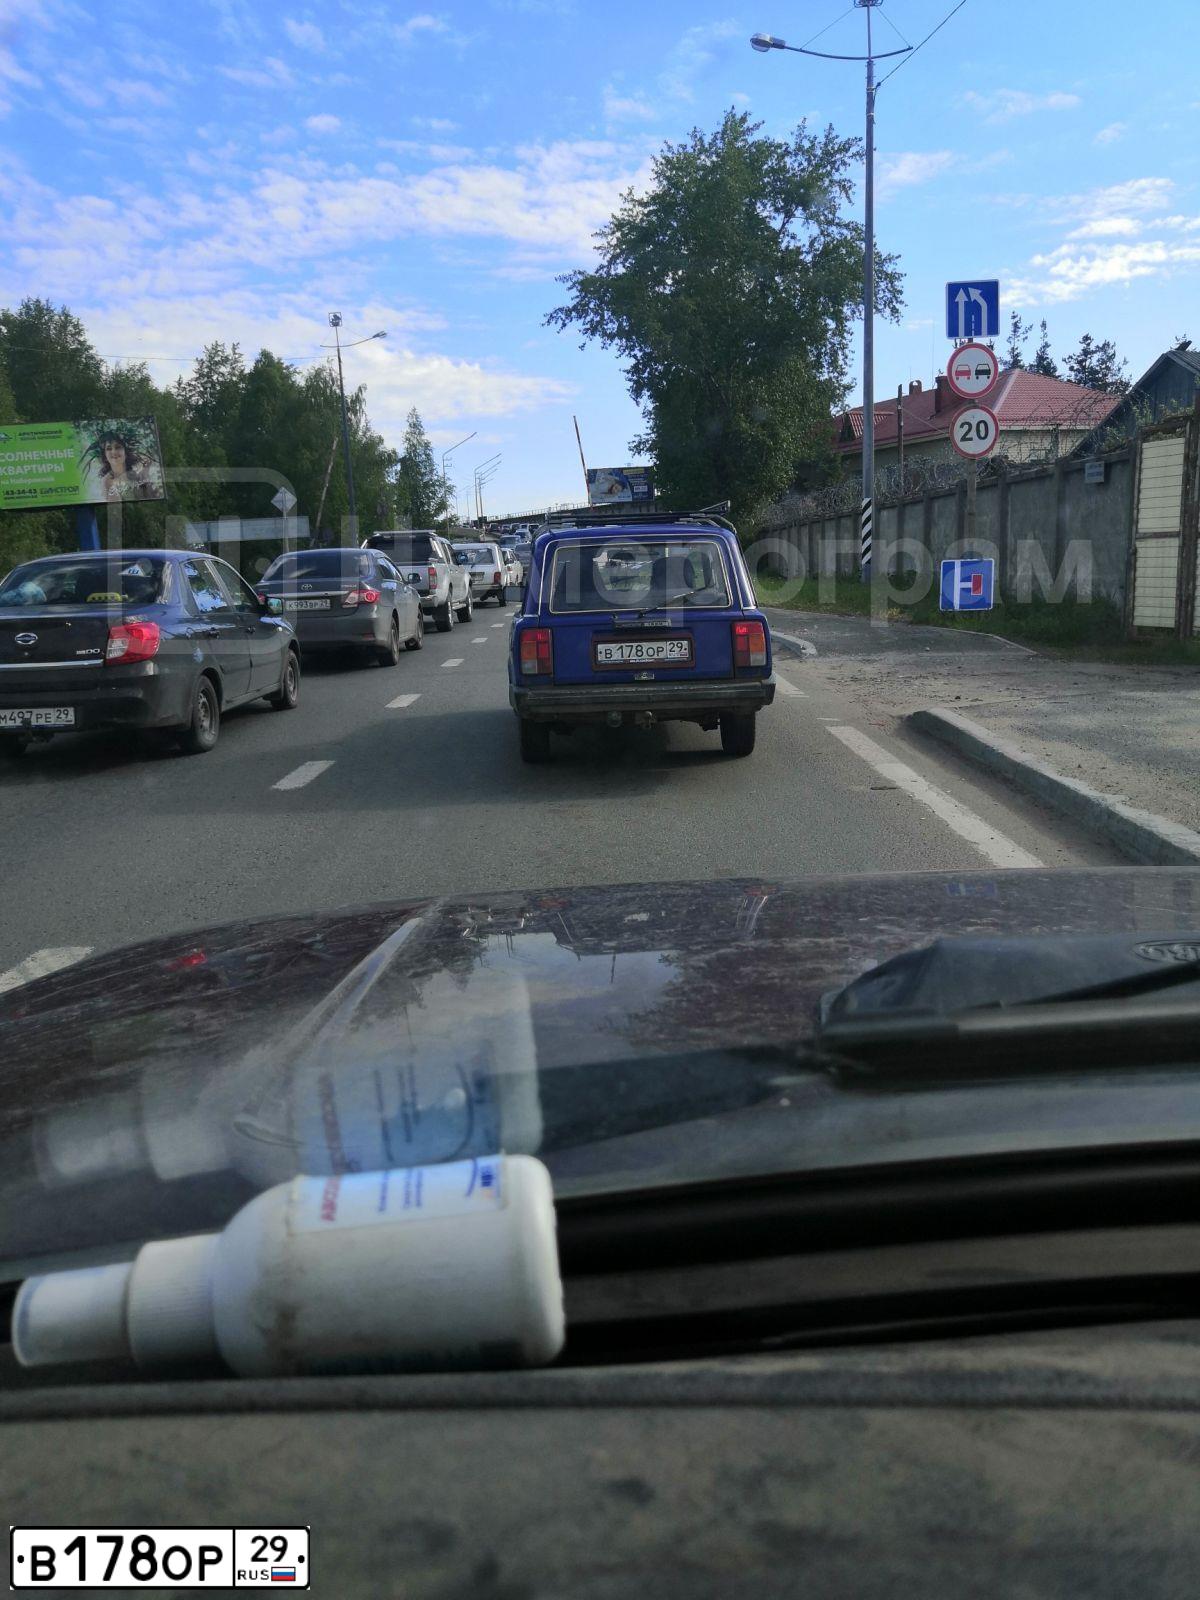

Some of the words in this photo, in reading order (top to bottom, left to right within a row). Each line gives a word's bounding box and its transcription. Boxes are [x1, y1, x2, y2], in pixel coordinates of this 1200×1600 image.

[959, 419, 990, 443] 20
[0, 448, 75, 463] СОЛНЕЧНЫЕ
[0, 462, 65, 476] КВАРТИРЫ
[604, 643, 665, 659] В178ОР
[668, 641, 683, 653] 29
[0, 711, 51, 724] М497РЕ
[56, 709, 69, 719] 29
